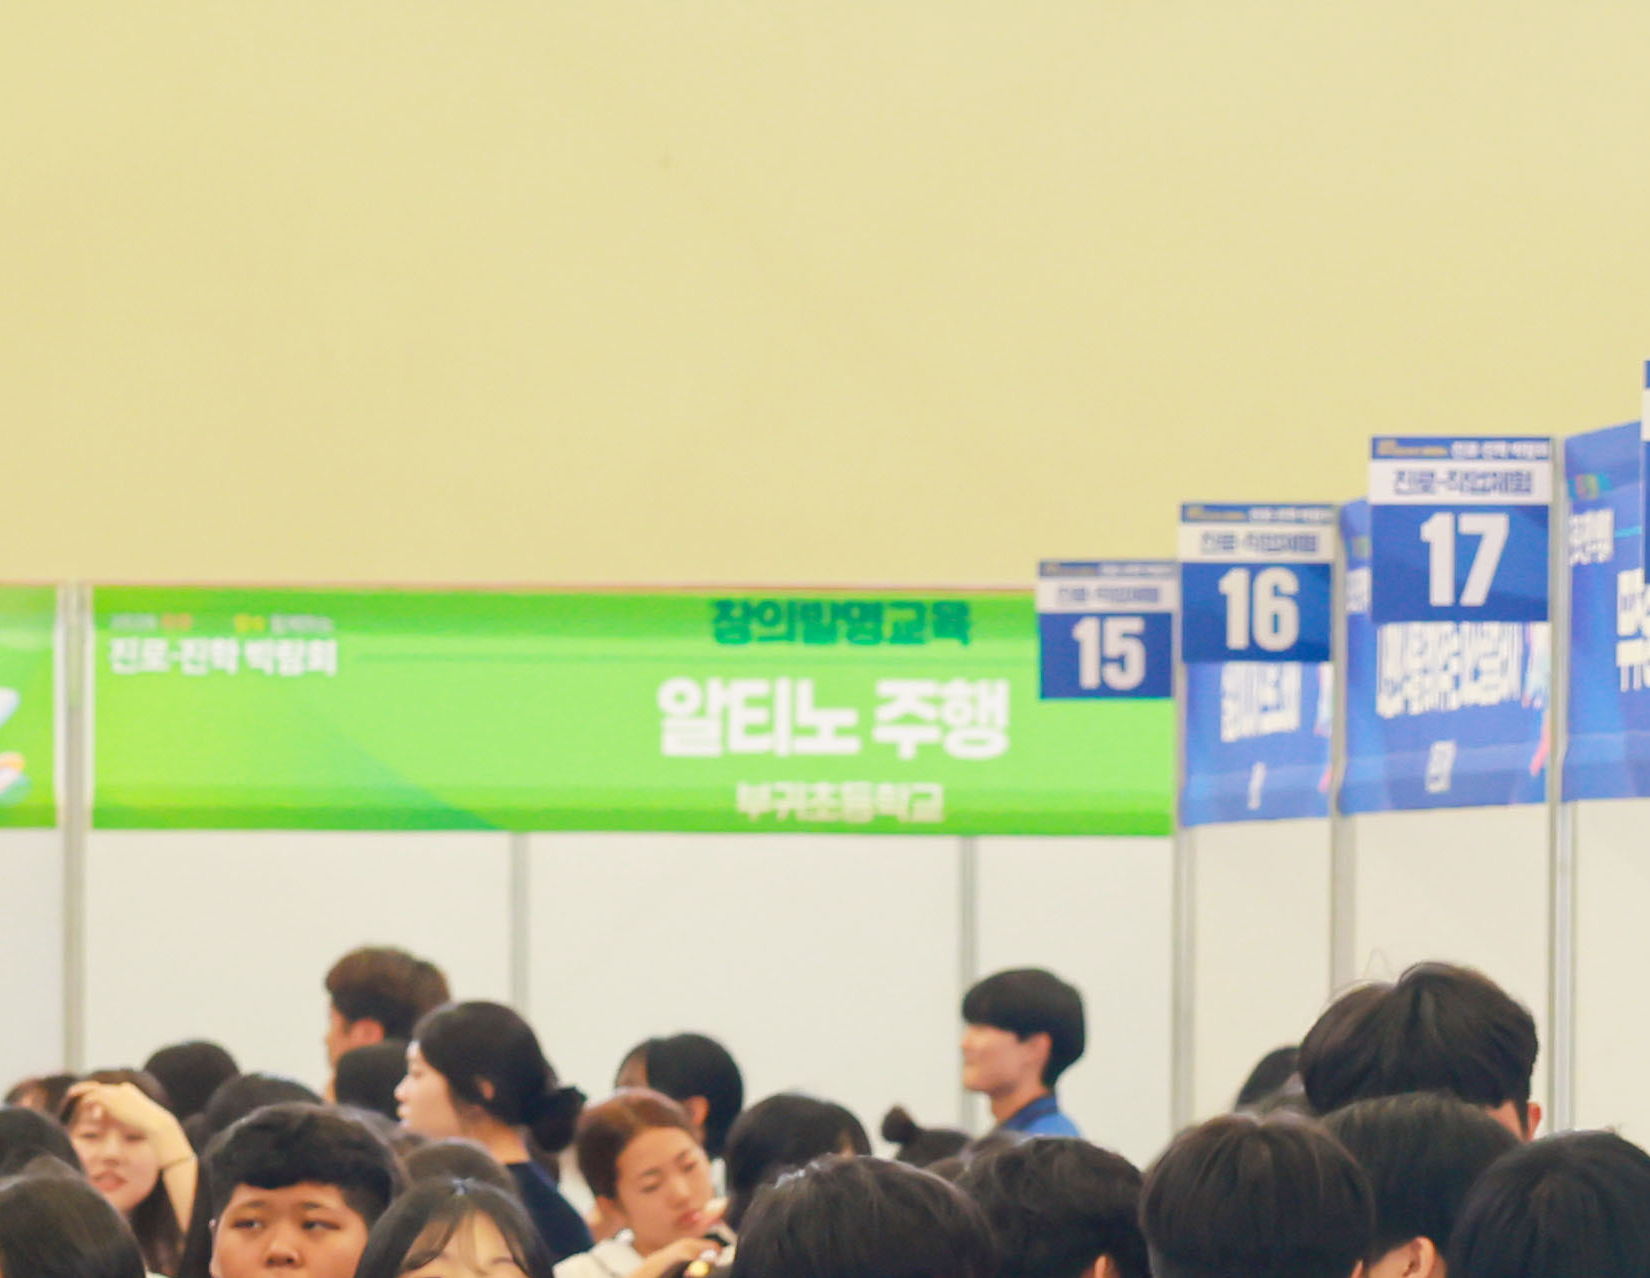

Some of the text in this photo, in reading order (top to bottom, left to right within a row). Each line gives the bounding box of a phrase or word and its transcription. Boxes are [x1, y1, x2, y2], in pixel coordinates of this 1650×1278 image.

[1419, 511, 1510, 607] 17
[1217, 567, 1300, 652] 16
[1072, 615, 1147, 691] 15
[656, 676, 1011, 761] 알티노 주행
